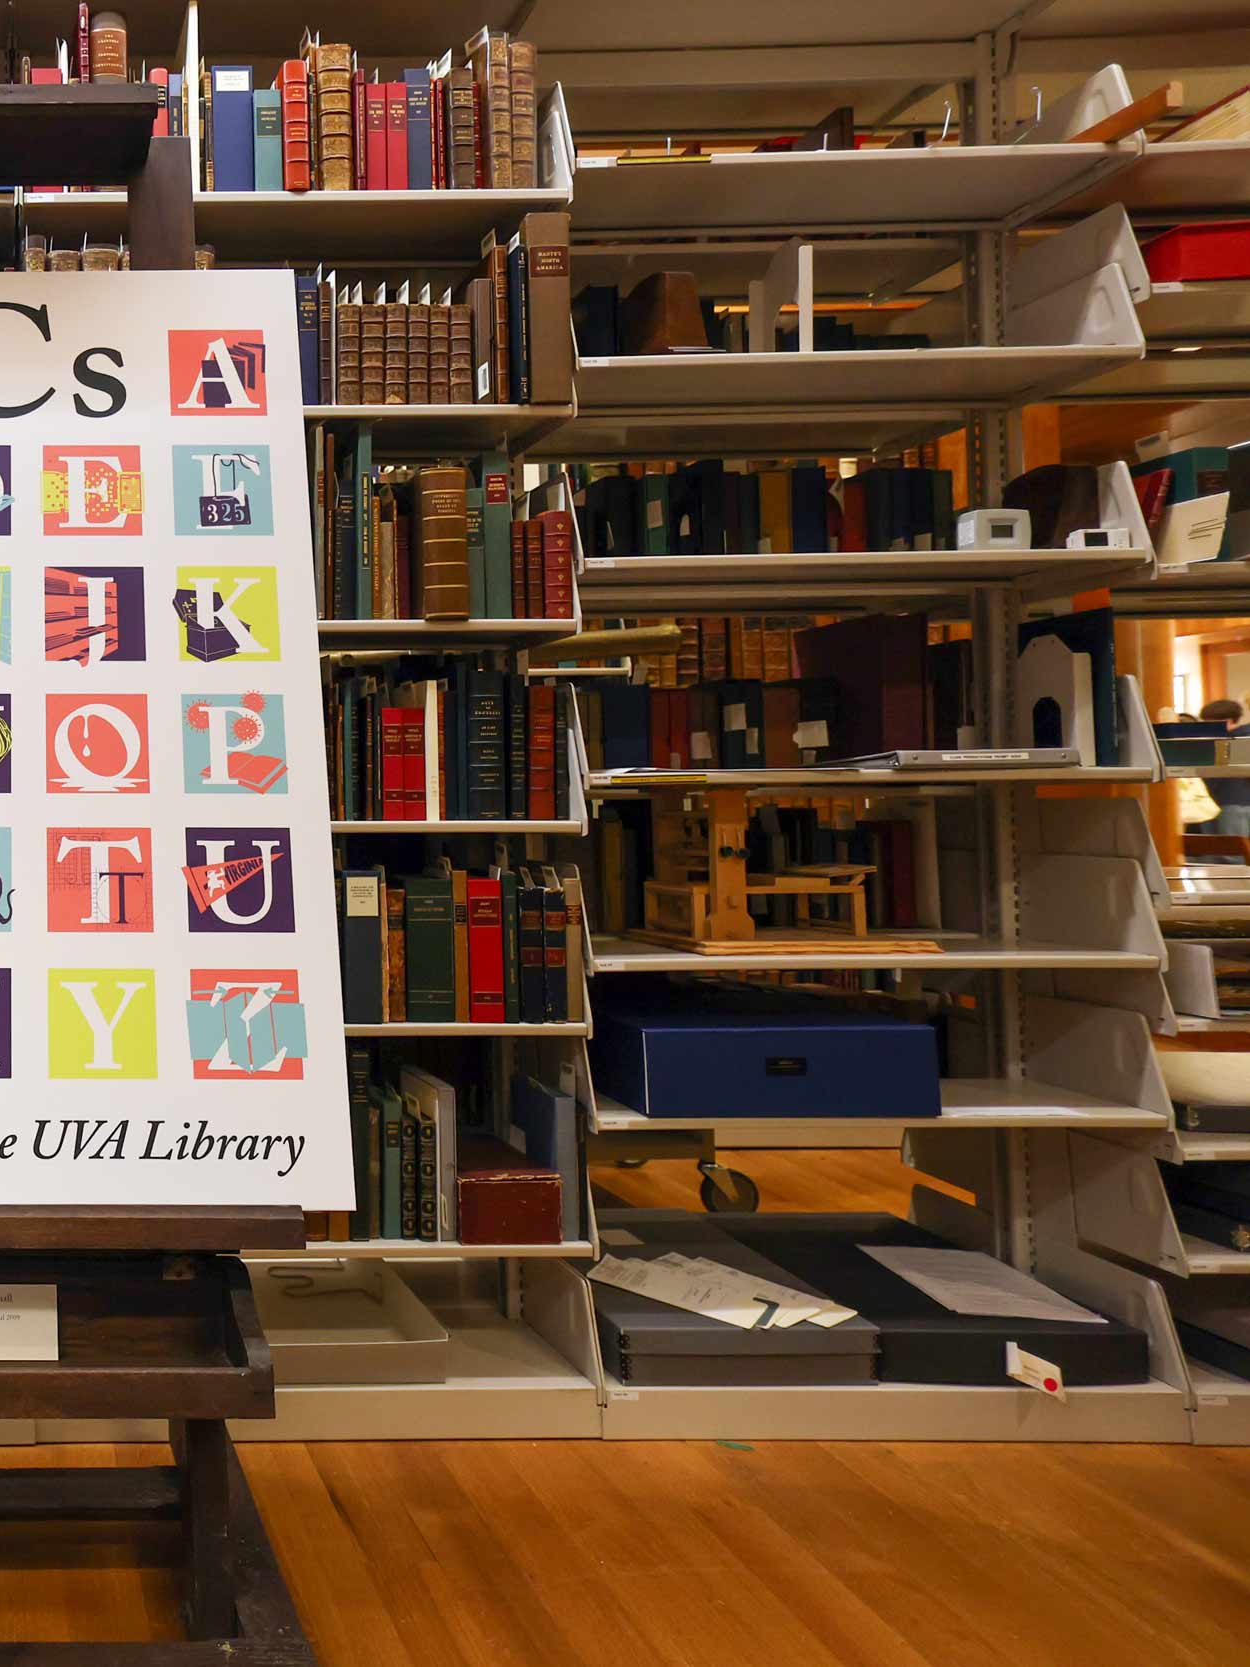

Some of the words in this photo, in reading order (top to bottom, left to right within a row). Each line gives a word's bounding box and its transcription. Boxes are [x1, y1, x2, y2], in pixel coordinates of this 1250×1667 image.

[177, 337, 260, 408] A
[59, 456, 128, 528] E
[207, 503, 245, 522] 325
[69, 577, 114, 668] J
[188, 577, 270, 653] K
[198, 706, 265, 784] P
[57, 836, 143, 923] T
[196, 840, 280, 925] U
[60, 982, 147, 1069] Y
[33, 1119, 130, 1160] UVA
[139, 1120, 306, 1177] Library
